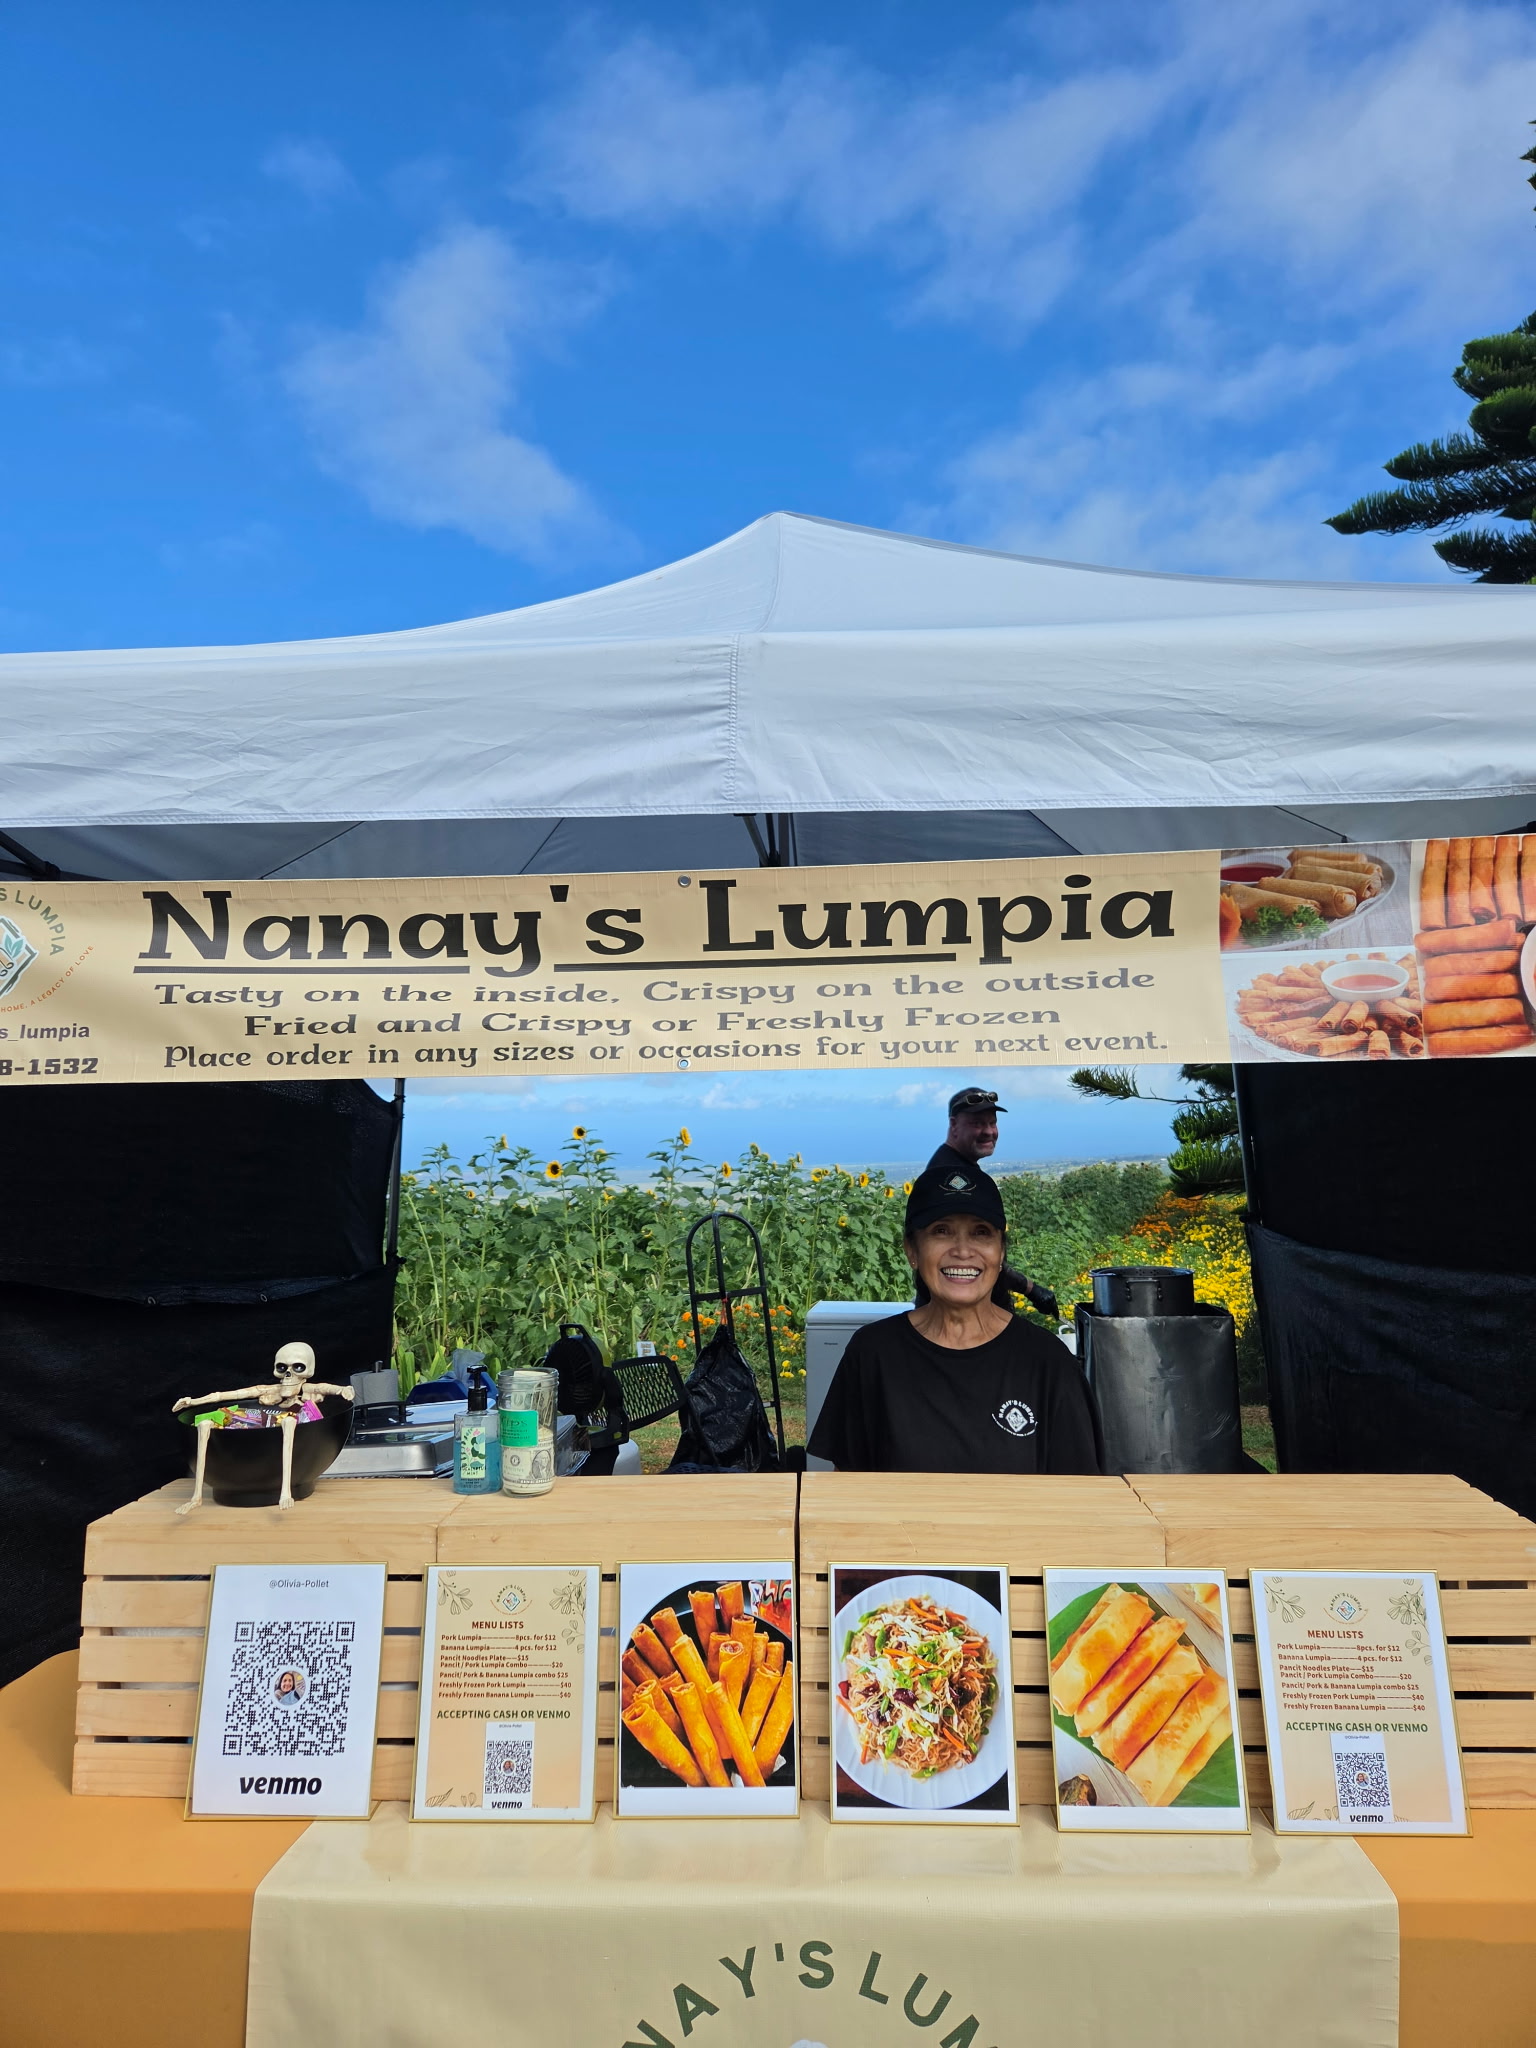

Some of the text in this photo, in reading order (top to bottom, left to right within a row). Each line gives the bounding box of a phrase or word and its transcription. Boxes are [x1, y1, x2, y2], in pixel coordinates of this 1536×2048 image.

[15, 889, 66, 956] LUMPIA
[138, 874, 1175, 978] Nanay's Lumpia
[37, 976, 65, 1002] LEGACY
[65, 966, 75, 977] OF
[75, 945, 94, 966] LOVE
[154, 967, 1156, 1009] Tasty on the inside, Crispy on the outside
[244, 1006, 1061, 1037] Fried and Crispy or Freshly Frozen
[163, 1030, 1169, 1068] Place order in any sizes or occasions for your next event.
[269, 1578, 329, 1589] @Olivia-Pollet
[471, 1621, 524, 1629] MENU LISTS
[1307, 1630, 1364, 1639] MENU LISTS
[1324, 1672, 1349, 1680] Lumpia
[503, 1681, 526, 1689] Lumpia
[1357, 1683, 1382, 1691] Lumpia
[511, 1691, 534, 1699] Lumpia
[1283, 1692, 1307, 1700] Freshly
[1350, 1693, 1376, 1701] Lumpia
[1360, 1704, 1386, 1712] Lumpia
[437, 1710, 571, 1719] ACCEPTING CASH OR VENMO
[1285, 1721, 1428, 1733] ACCEPTING CASH OR VENMO
[239, 1776, 322, 1795] venmo
[491, 1801, 523, 1809] venmo
[1350, 1814, 1384, 1823] venmo
